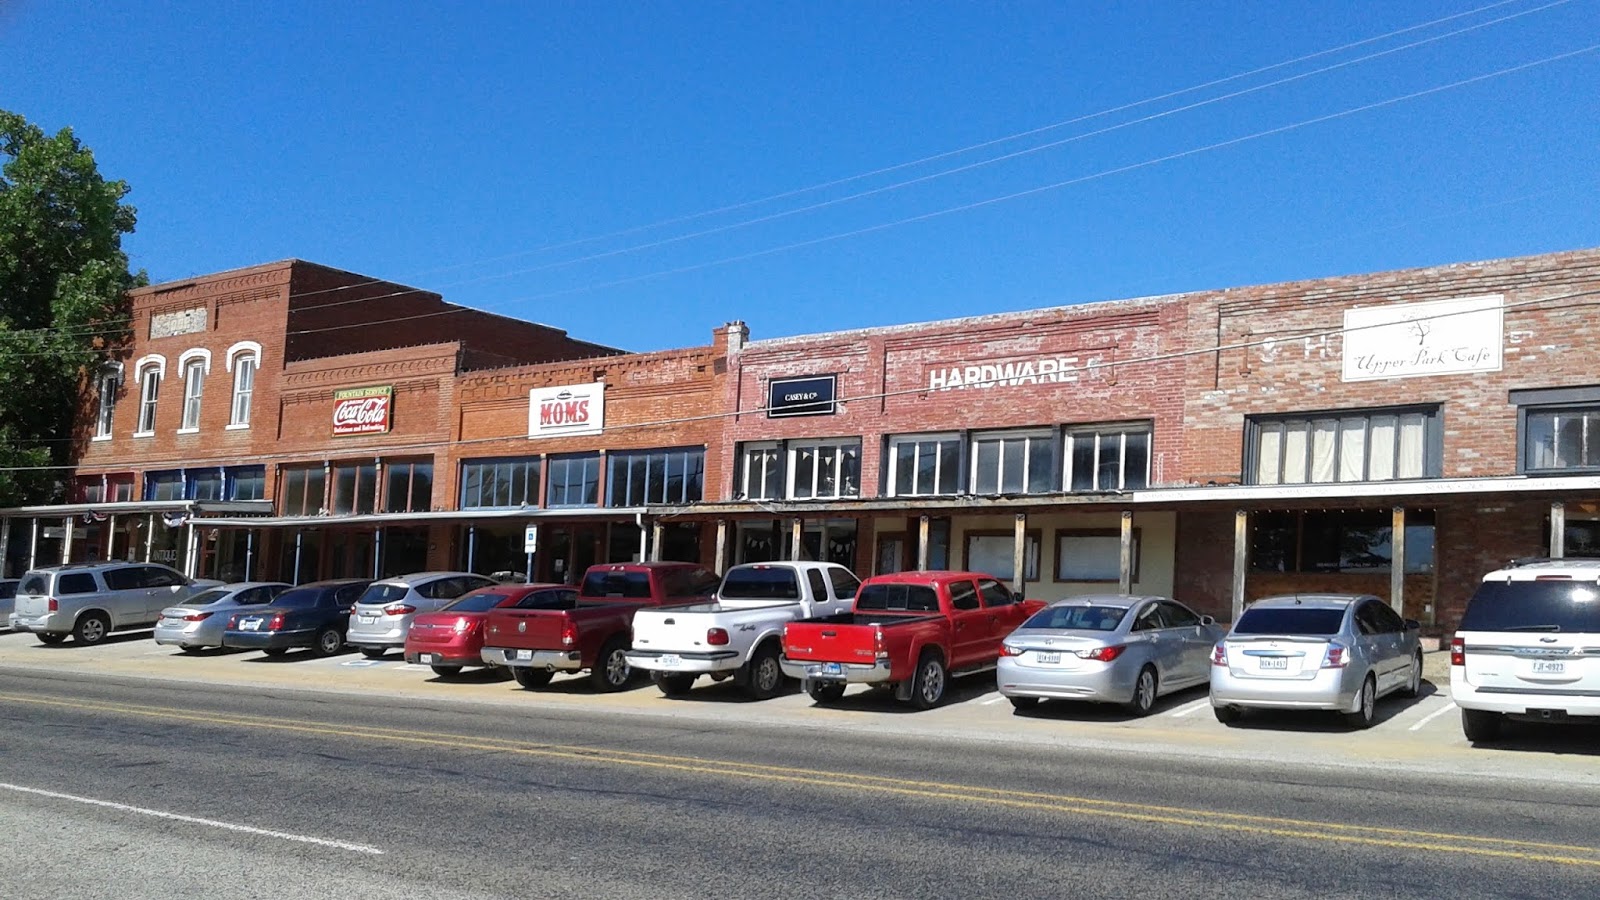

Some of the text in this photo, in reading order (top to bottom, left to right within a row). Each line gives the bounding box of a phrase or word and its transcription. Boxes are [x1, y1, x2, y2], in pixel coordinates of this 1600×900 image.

[1354, 355, 1406, 374] Upper
[1410, 347, 1446, 366] Park
[929, 357, 1079, 392] HARDWARE
[785, 393, 803, 401] CASEY
[803, 392, 809, 400] &
[540, 400, 589, 425] MOMS
